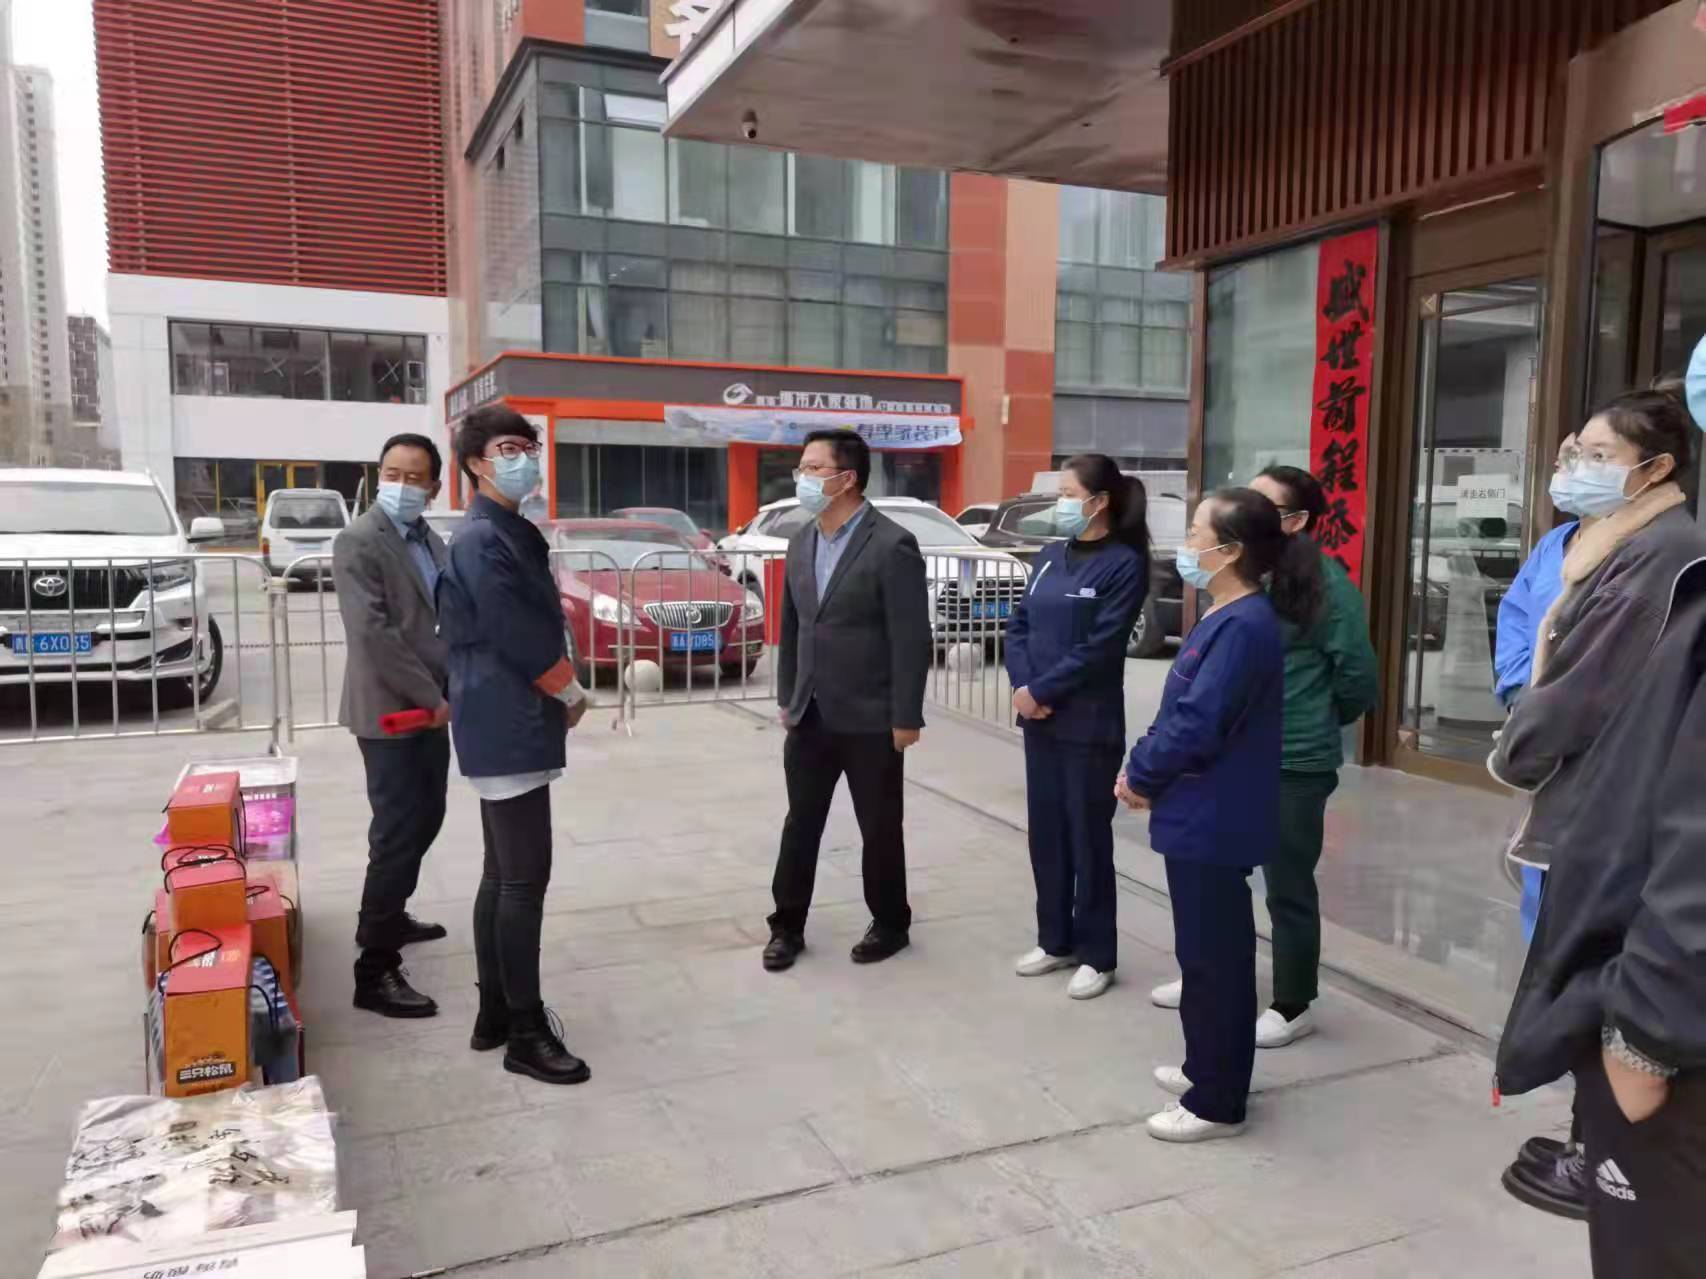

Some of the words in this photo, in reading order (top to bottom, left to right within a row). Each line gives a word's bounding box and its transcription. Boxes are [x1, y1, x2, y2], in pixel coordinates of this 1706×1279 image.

[1314, 258, 1370, 572] 盛世前程添
